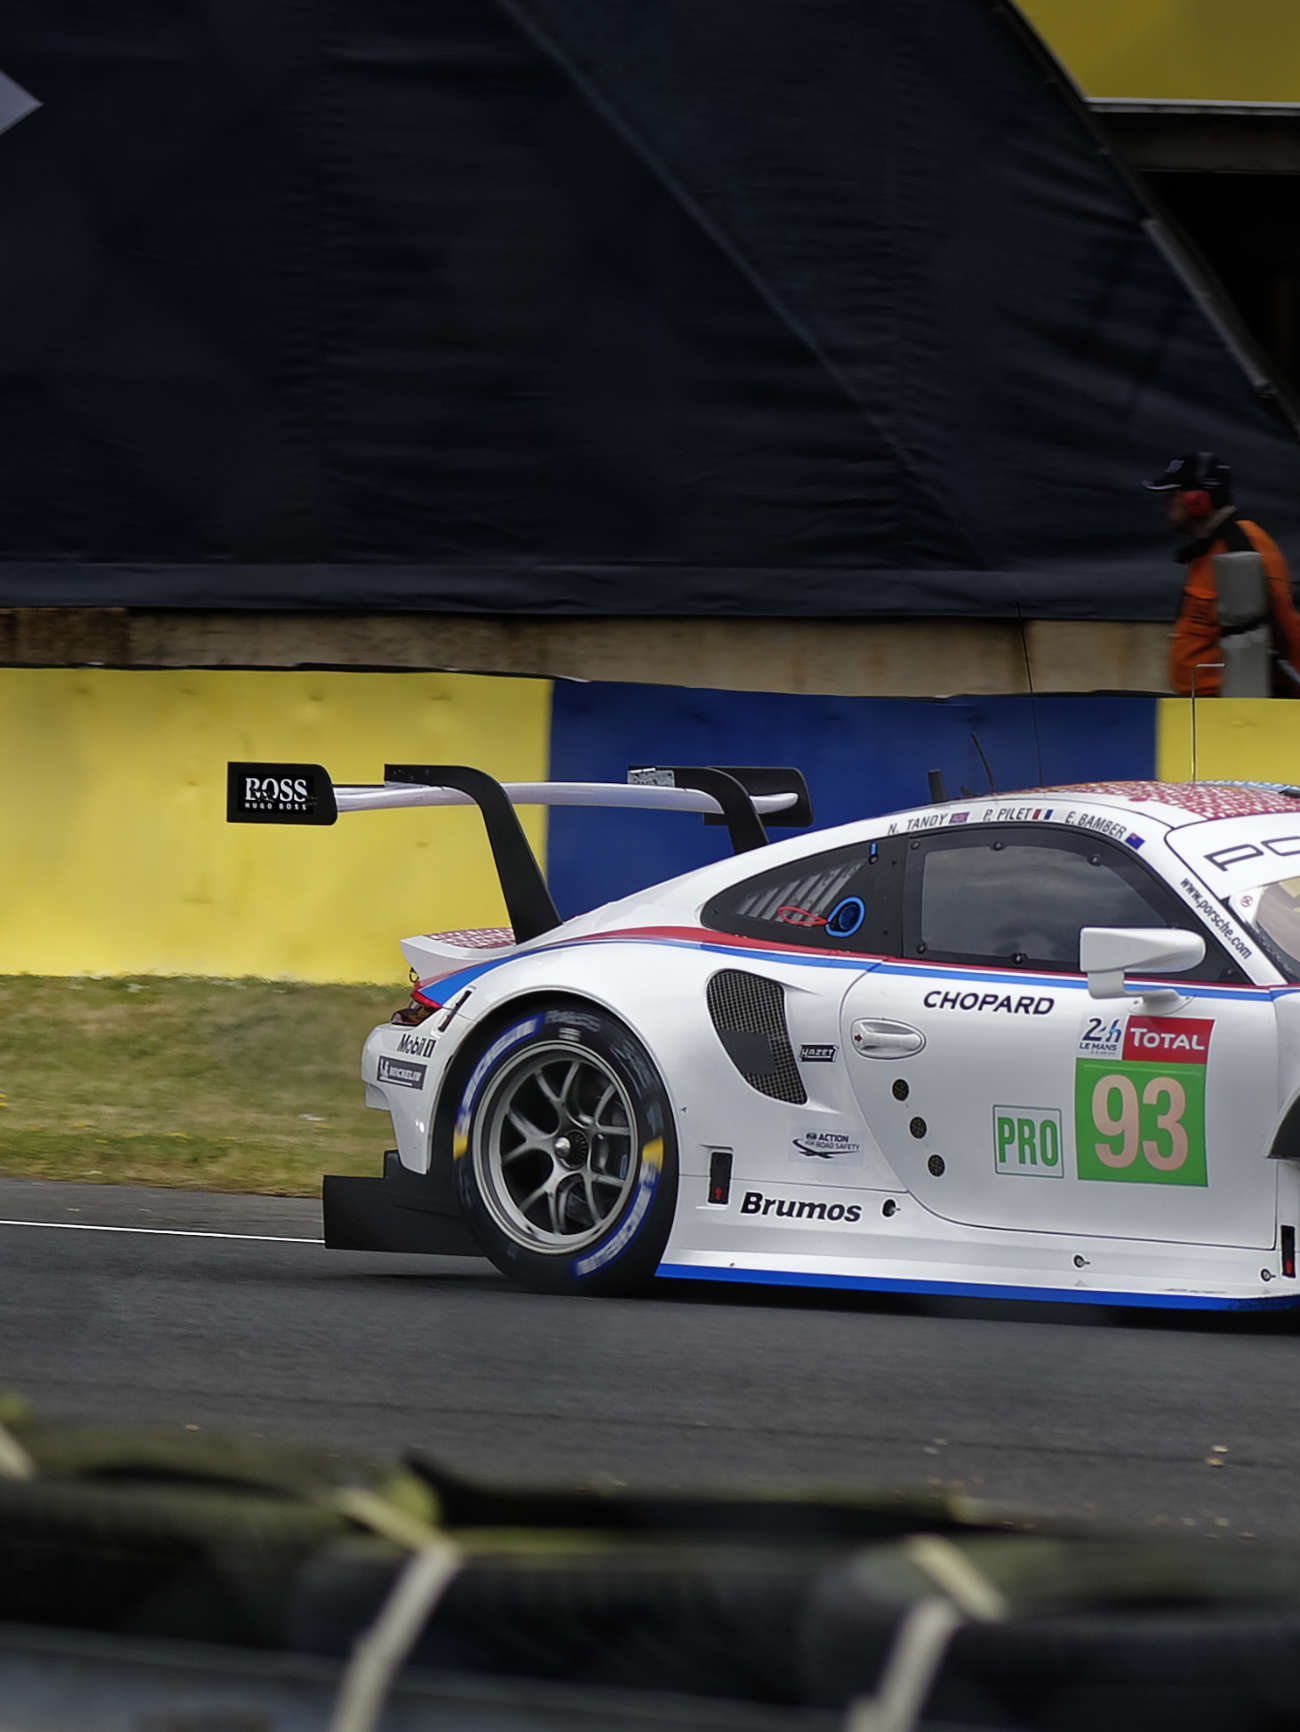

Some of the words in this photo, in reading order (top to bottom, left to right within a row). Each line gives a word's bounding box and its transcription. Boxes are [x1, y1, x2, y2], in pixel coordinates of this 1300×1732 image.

[279, 803, 307, 811] BOSS
[982, 808, 993, 822] P.
[996, 808, 1033, 821] PILET
[887, 822, 900, 835] N.
[906, 813, 949, 831] TANDY
[1064, 811, 1076, 826] E.
[1077, 815, 1127, 838] BAMBER
[1179, 878, 1253, 960] www.porsche.com
[923, 990, 1055, 1015] CHOPARD
[397, 1033, 427, 1055] Mobil
[1092, 1043, 1117, 1051] MANS
[1130, 1028, 1205, 1050] TOTAL
[801, 1048, 834, 1058] HAZET
[1092, 1074, 1188, 1171] 93
[816, 1141, 834, 1149] ROAD
[835, 1142, 860, 1150] SAFETY
[818, 1133, 850, 1143] ACTION
[997, 1116, 1059, 1167] PRO
[740, 1191, 862, 1222] Brumos
